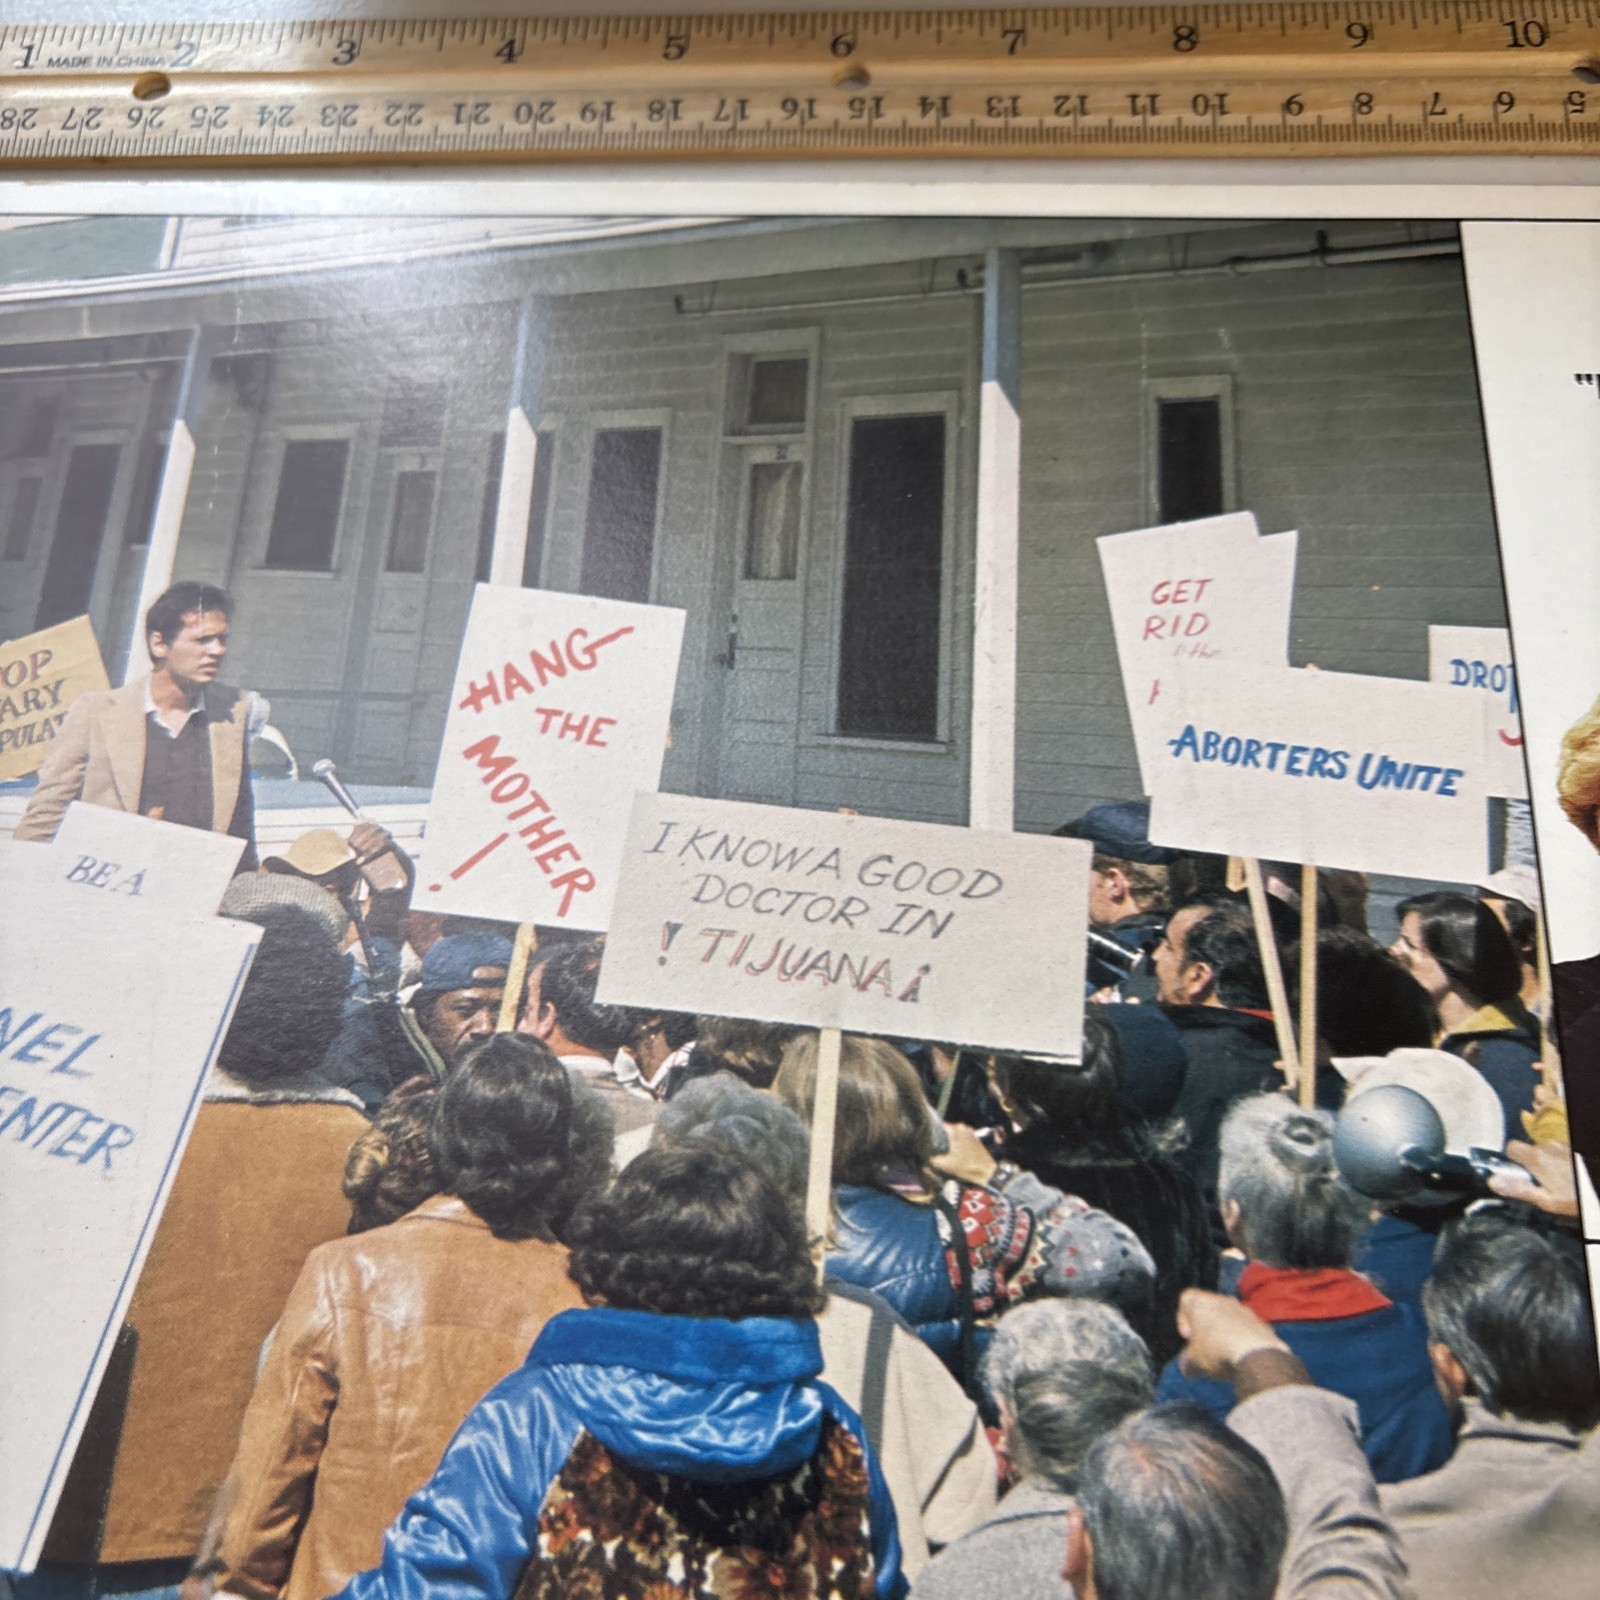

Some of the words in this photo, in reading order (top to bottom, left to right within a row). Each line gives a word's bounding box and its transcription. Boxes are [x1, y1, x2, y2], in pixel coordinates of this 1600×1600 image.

[16, 44, 34, 69] 1
[170, 42, 198, 67] 2
[332, 40, 357, 65] 3
[494, 39, 518, 64] 4
[663, 35, 686, 60] 5
[829, 33, 854, 57] 6
[1001, 29, 1025, 55] 7
[1172, 25, 1198, 52] 8
[1346, 22, 1369, 48] 9
[1503, 20, 1548, 48] 10
[47, 56, 93, 67] MADE
[97, 56, 113, 67] IN
[116, 55, 165, 67] CHINA
[514, 100, 556, 126] 20
[580, 99, 618, 124] 19
[647, 99, 683, 123] 18
[713, 98, 748, 123] 17
[780, 98, 818, 120] 16
[849, 97, 885, 120] 15
[918, 96, 951, 119] 14
[986, 95, 1023, 119] 13
[1053, 94, 1089, 118] 12
[1127, 93, 1161, 117] 11
[1191, 93, 1231, 117] 10
[1286, 93, 1304, 116] 9
[1355, 92, 1374, 115] 8
[1429, 92, 1447, 116] 7
[1498, 90, 1516, 113] 6
[1566, 90, 1586, 114] 5
[0, 107, 38, 131] 28
[61, 107, 103, 131] 27
[127, 106, 166, 130] 26
[190, 107, 230, 130] 25
[257, 105, 294, 129] 24
[320, 104, 360, 128] 23
[384, 102, 424, 127] 22
[453, 102, 490, 127] 21
[1151, 578, 1214, 605] GET
[1142, 612, 1210, 641] RID
[0, 649, 53, 688] OP
[459, 627, 634, 713] HANG
[535, 707, 617, 747] THE
[1167, 724, 1350, 779] ABORTERS
[462, 734, 596, 917] MOTHER
[643, 822, 678, 854] I
[678, 829, 813, 873] KNOW
[807, 848, 841, 880] A
[858, 854, 1003, 899] GOOD
[690, 872, 871, 929] DOCTOR
[879, 902, 955, 940] IN
